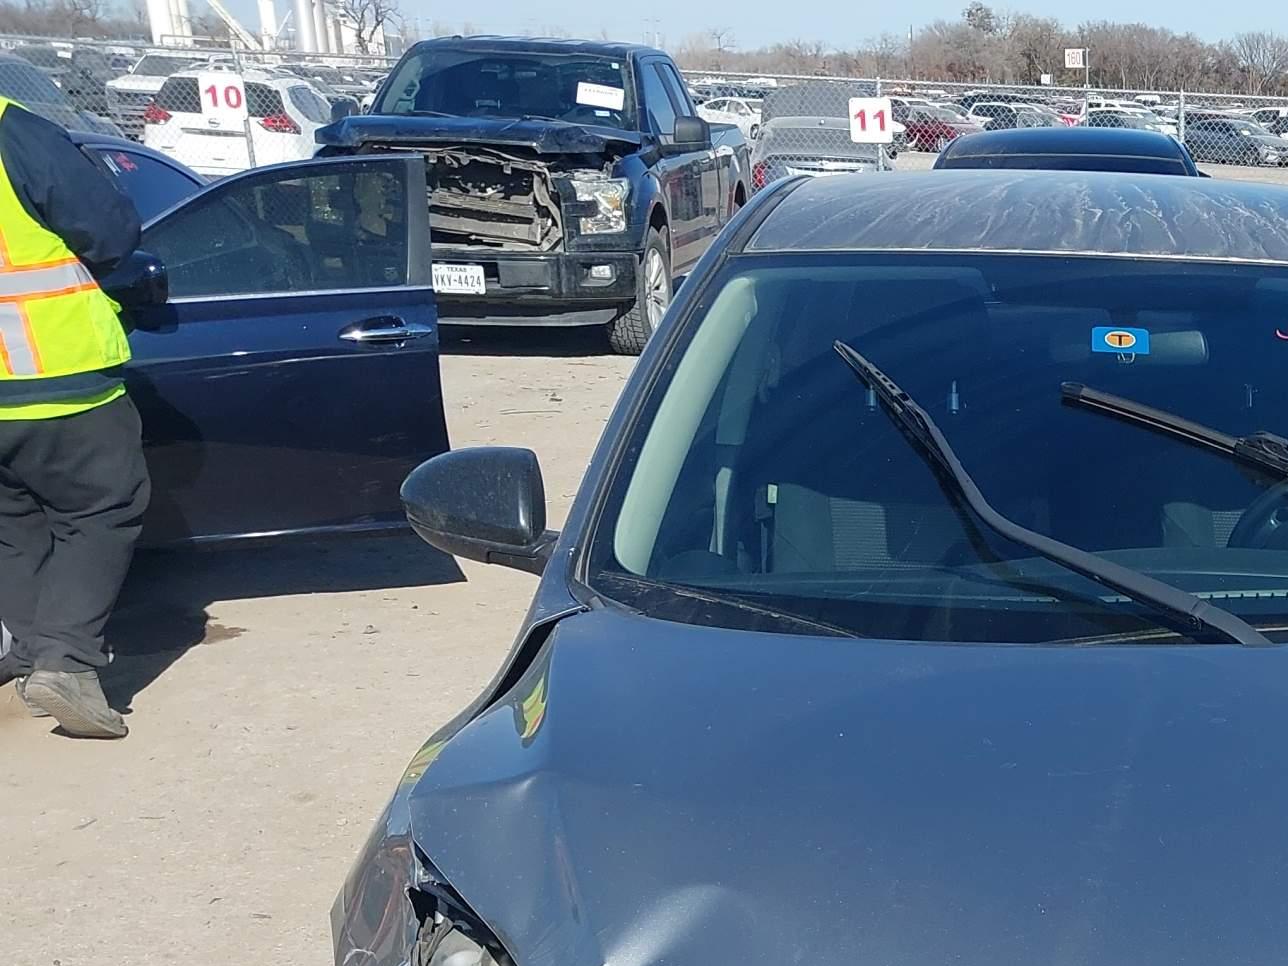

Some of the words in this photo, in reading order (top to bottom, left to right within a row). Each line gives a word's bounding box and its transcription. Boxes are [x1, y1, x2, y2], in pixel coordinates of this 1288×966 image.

[204, 84, 242, 109] 10
[853, 109, 886, 132] 11
[1110, 333, 1130, 346] T
